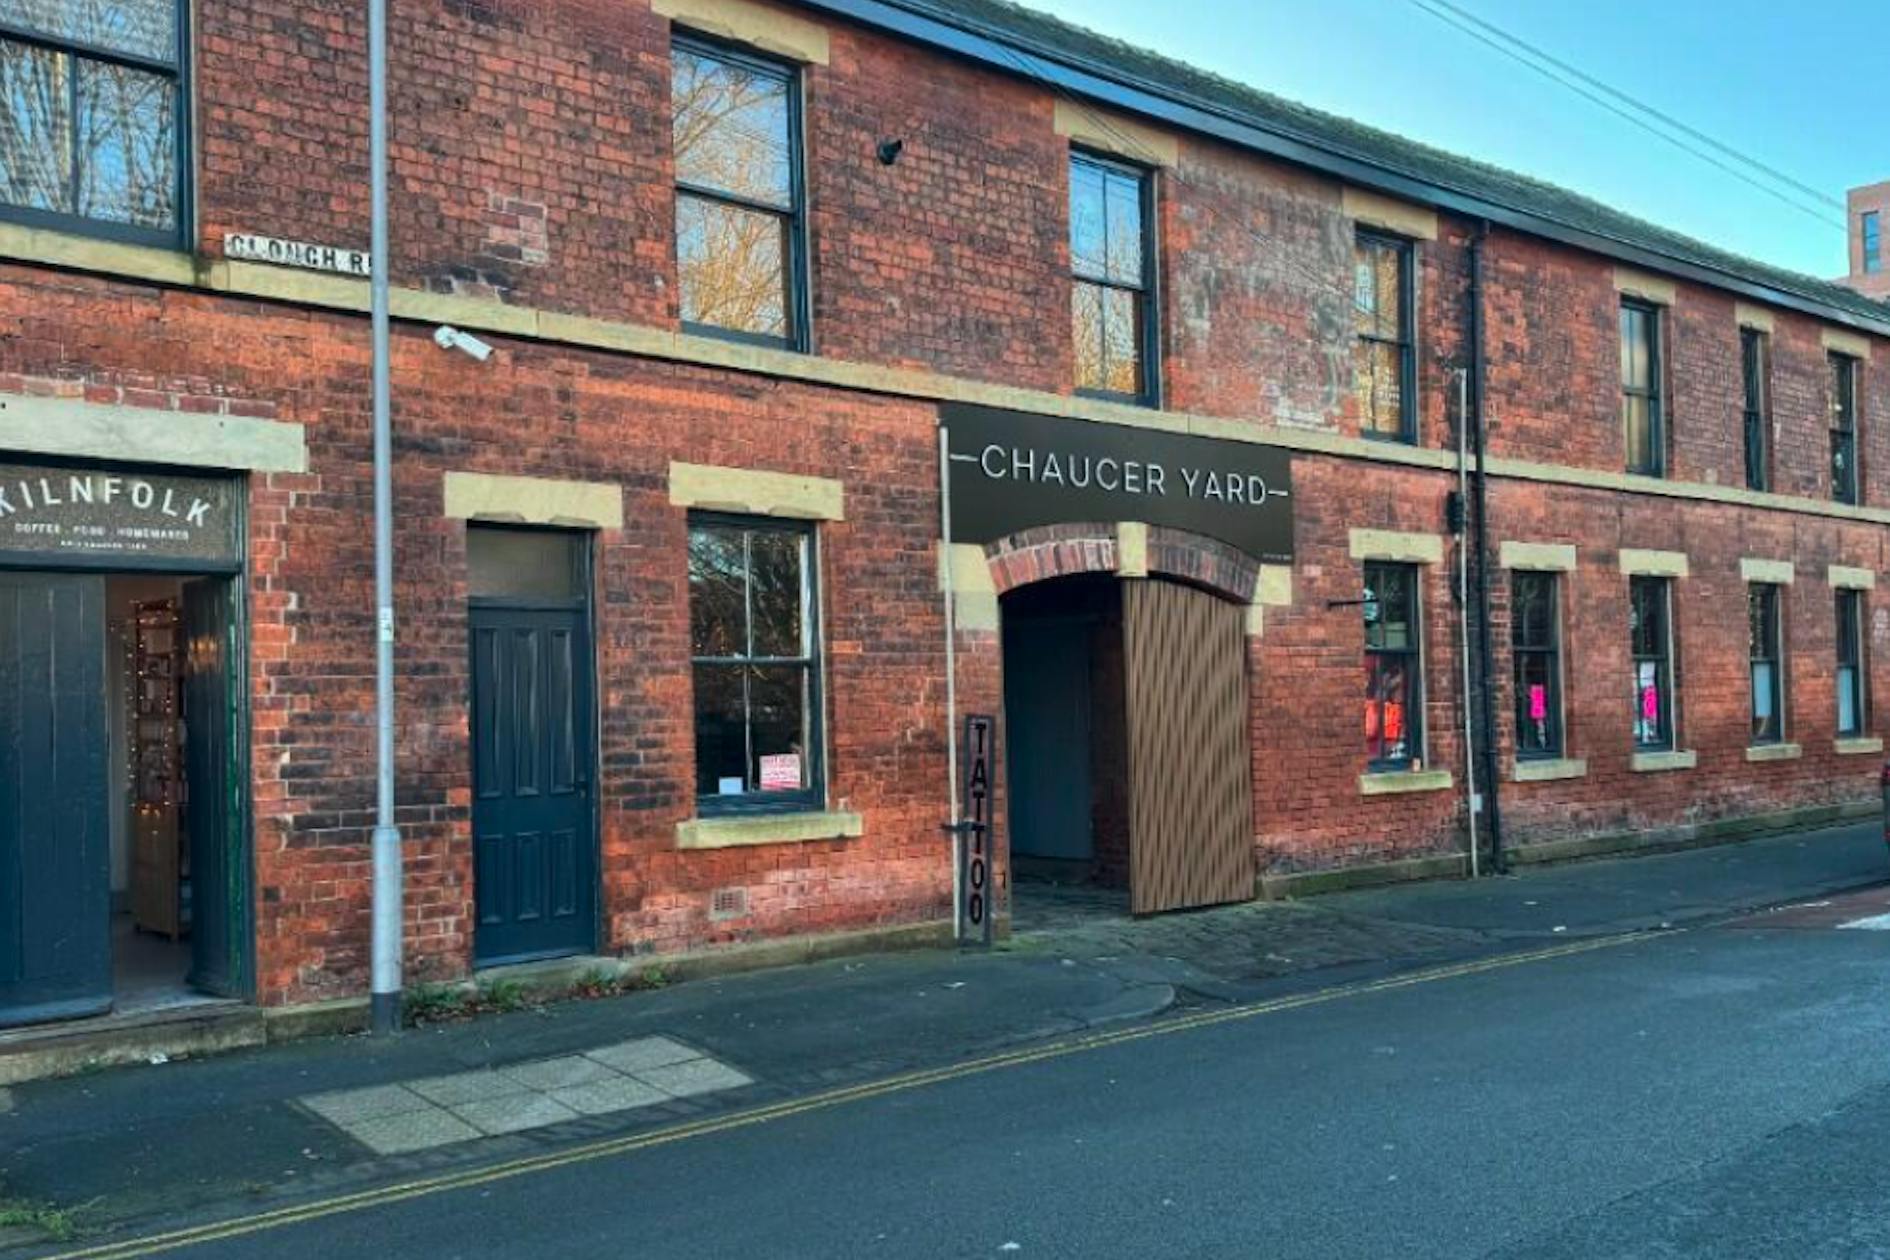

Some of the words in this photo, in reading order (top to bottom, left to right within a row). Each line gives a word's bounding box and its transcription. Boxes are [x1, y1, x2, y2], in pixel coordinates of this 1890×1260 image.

[350, 252, 373, 272] R
[981, 445, 1166, 496] CHAUCER
[1181, 467, 1266, 505] YARD
[970, 722, 988, 925] TATTOO
